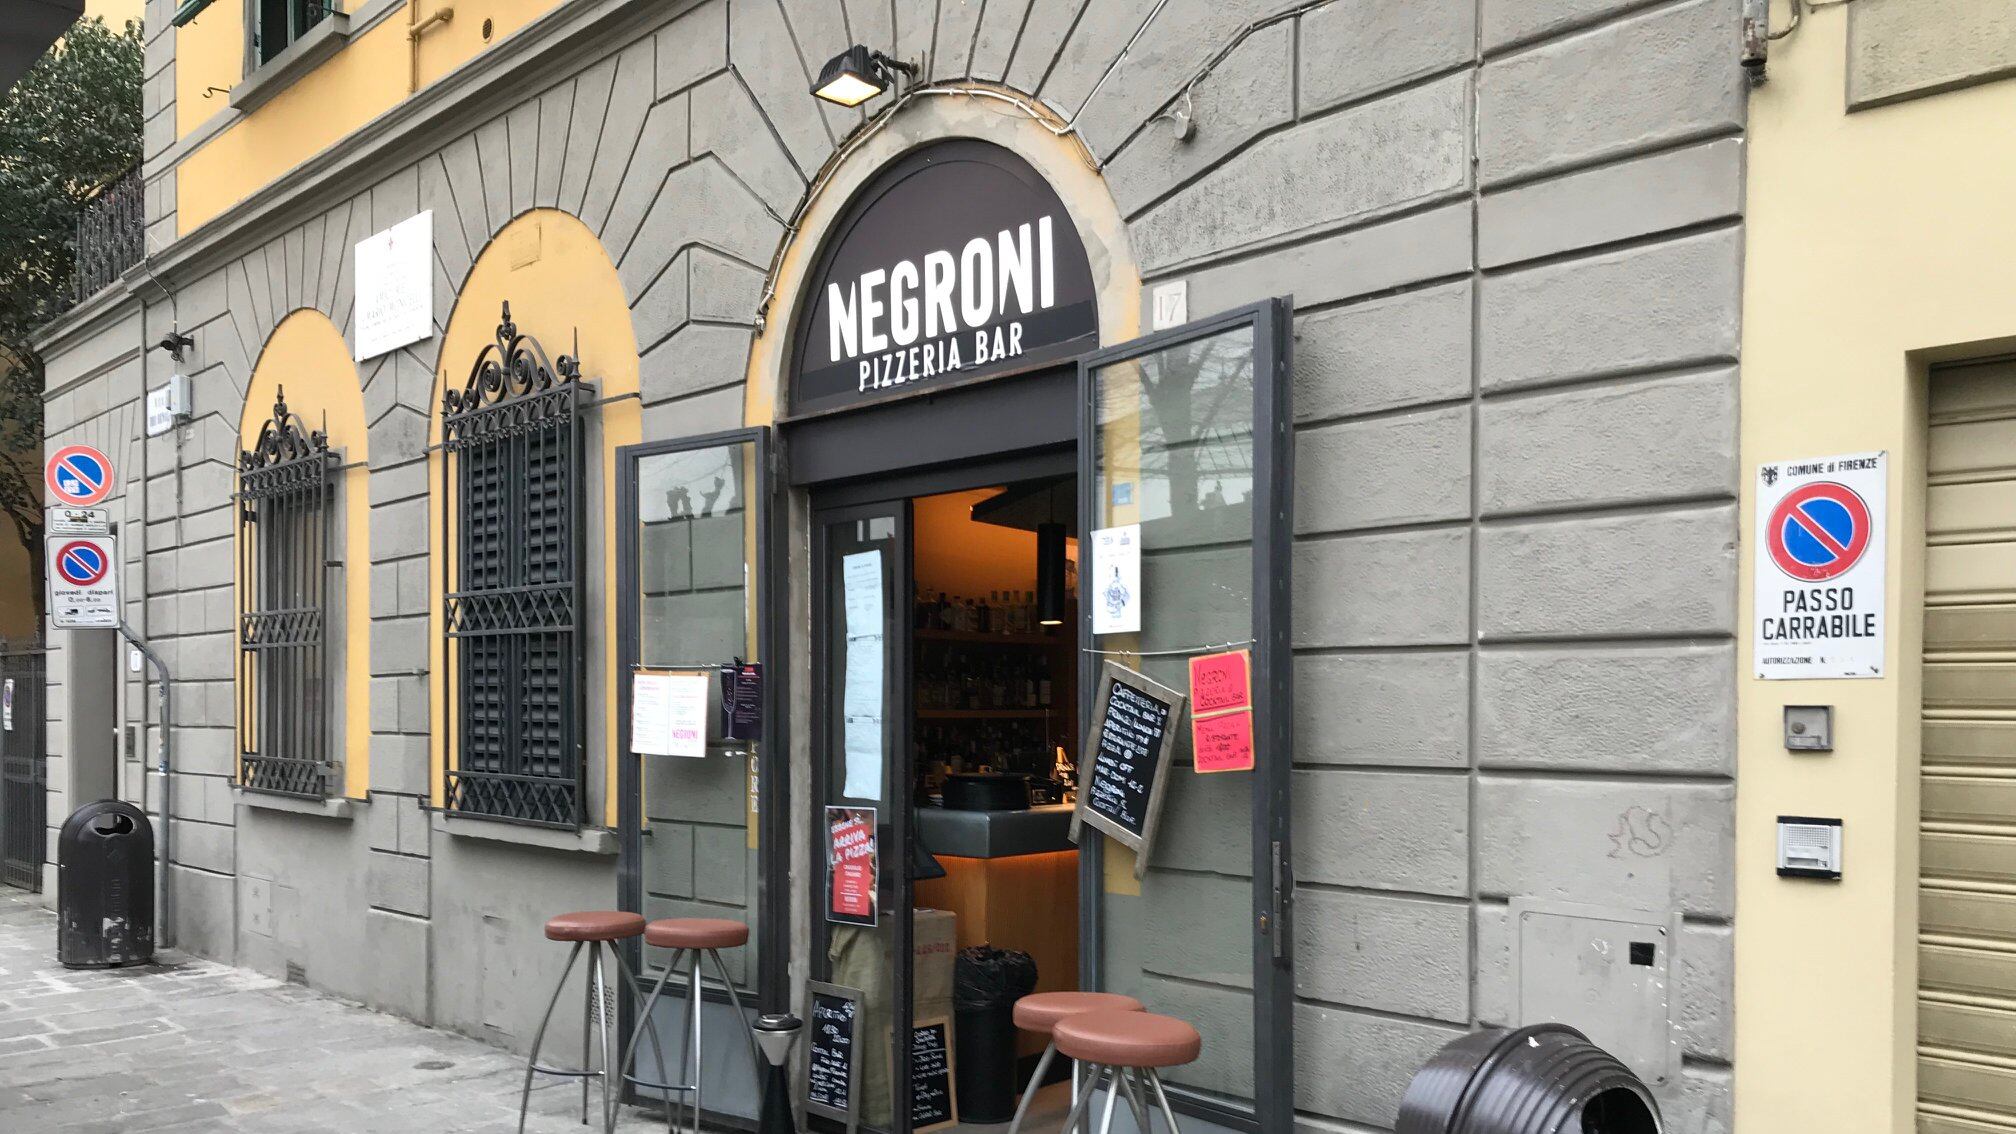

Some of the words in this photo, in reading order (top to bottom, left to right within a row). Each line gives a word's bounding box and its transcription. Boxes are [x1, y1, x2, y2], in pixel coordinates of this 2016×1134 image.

[828, 215, 1055, 362] NEGRONI
[1156, 292, 1182, 322] 17
[858, 343, 961, 392] PIZZERIA
[974, 322, 1024, 366] BAR
[1787, 463, 1824, 477] COMUNE
[1827, 462, 1835, 473] di
[1838, 458, 1878, 472] FIRENZE
[1783, 587, 1854, 613] PASSO
[1762, 613, 1876, 640] CARRABILE
[1762, 656, 1813, 665] AUTORIZZAZIONE
